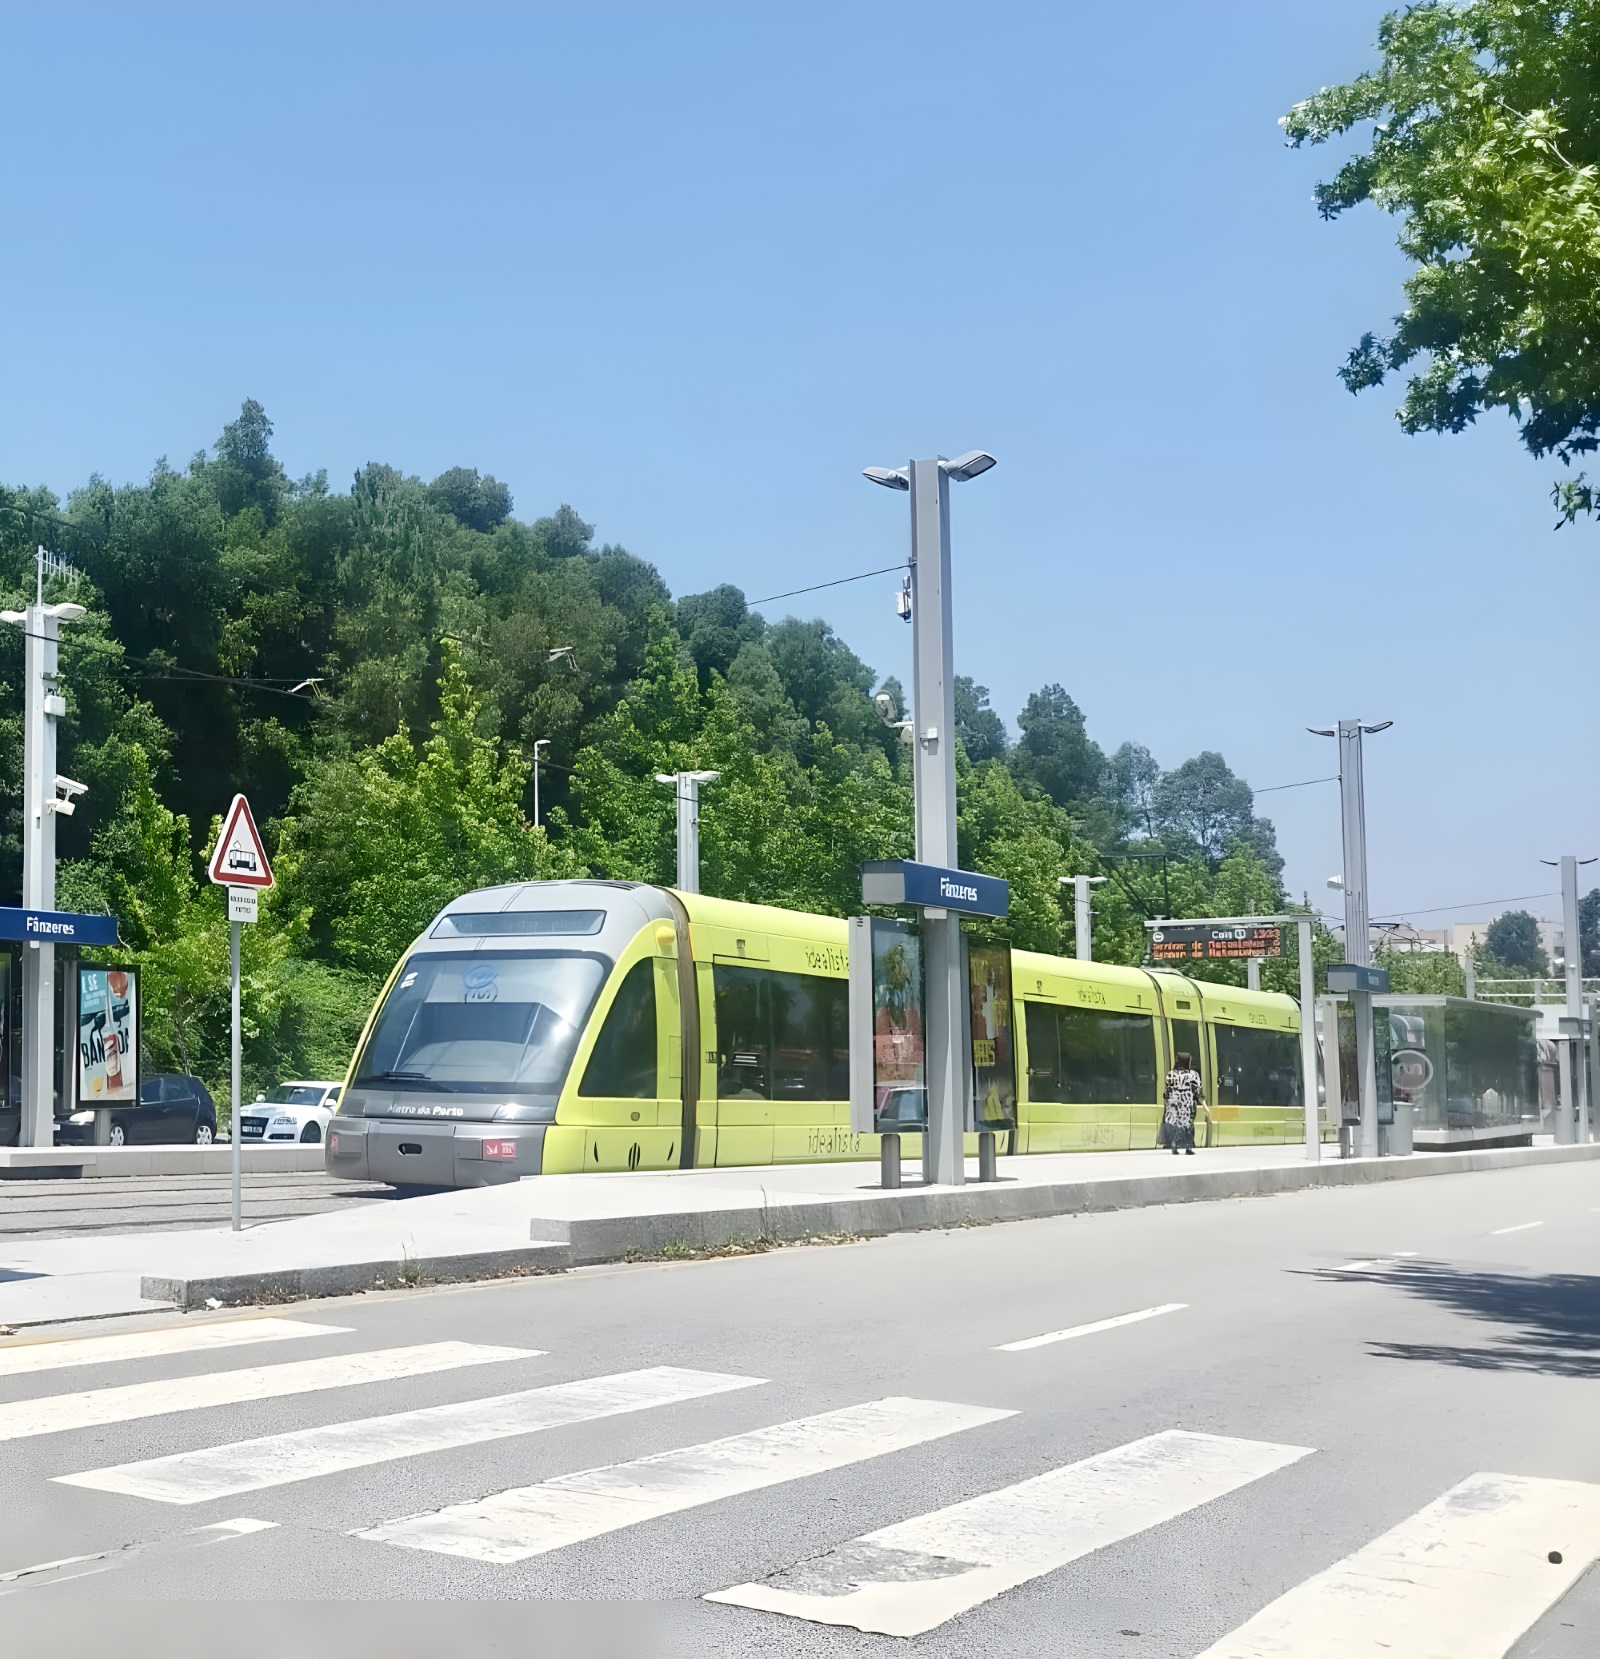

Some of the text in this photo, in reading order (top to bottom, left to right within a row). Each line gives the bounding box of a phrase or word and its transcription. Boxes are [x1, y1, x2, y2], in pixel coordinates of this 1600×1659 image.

[26, 916, 75, 935] Fânzeres
[432, 1105, 464, 1117] Porto
[808, 1127, 861, 1154] idealista
